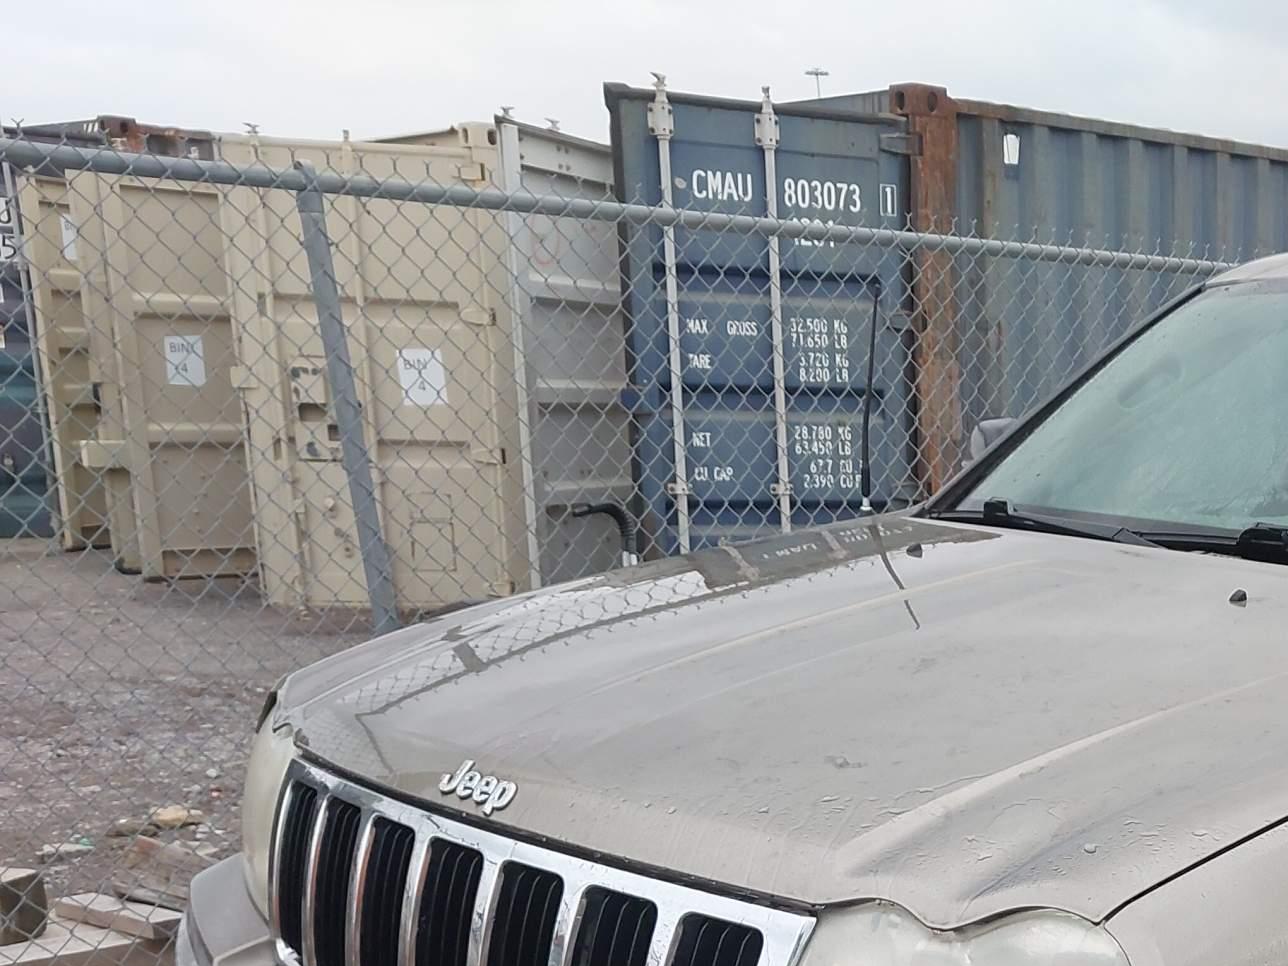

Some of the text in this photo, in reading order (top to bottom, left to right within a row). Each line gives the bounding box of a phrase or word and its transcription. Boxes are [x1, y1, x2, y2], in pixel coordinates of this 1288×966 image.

[692, 169, 753, 201] CMAU
[783, 178, 861, 213] 803073
[686, 319, 709, 334] MAX
[726, 320, 758, 336] GROSS
[833, 319, 848, 333] KG
[169, 341, 193, 353] BIN
[834, 334, 848, 349] LB
[688, 353, 713, 369] TARE
[835, 352, 850, 368] KG
[835, 367, 850, 383] LB
[838, 441, 852, 456] LB
[439, 759, 518, 817] Jeep
